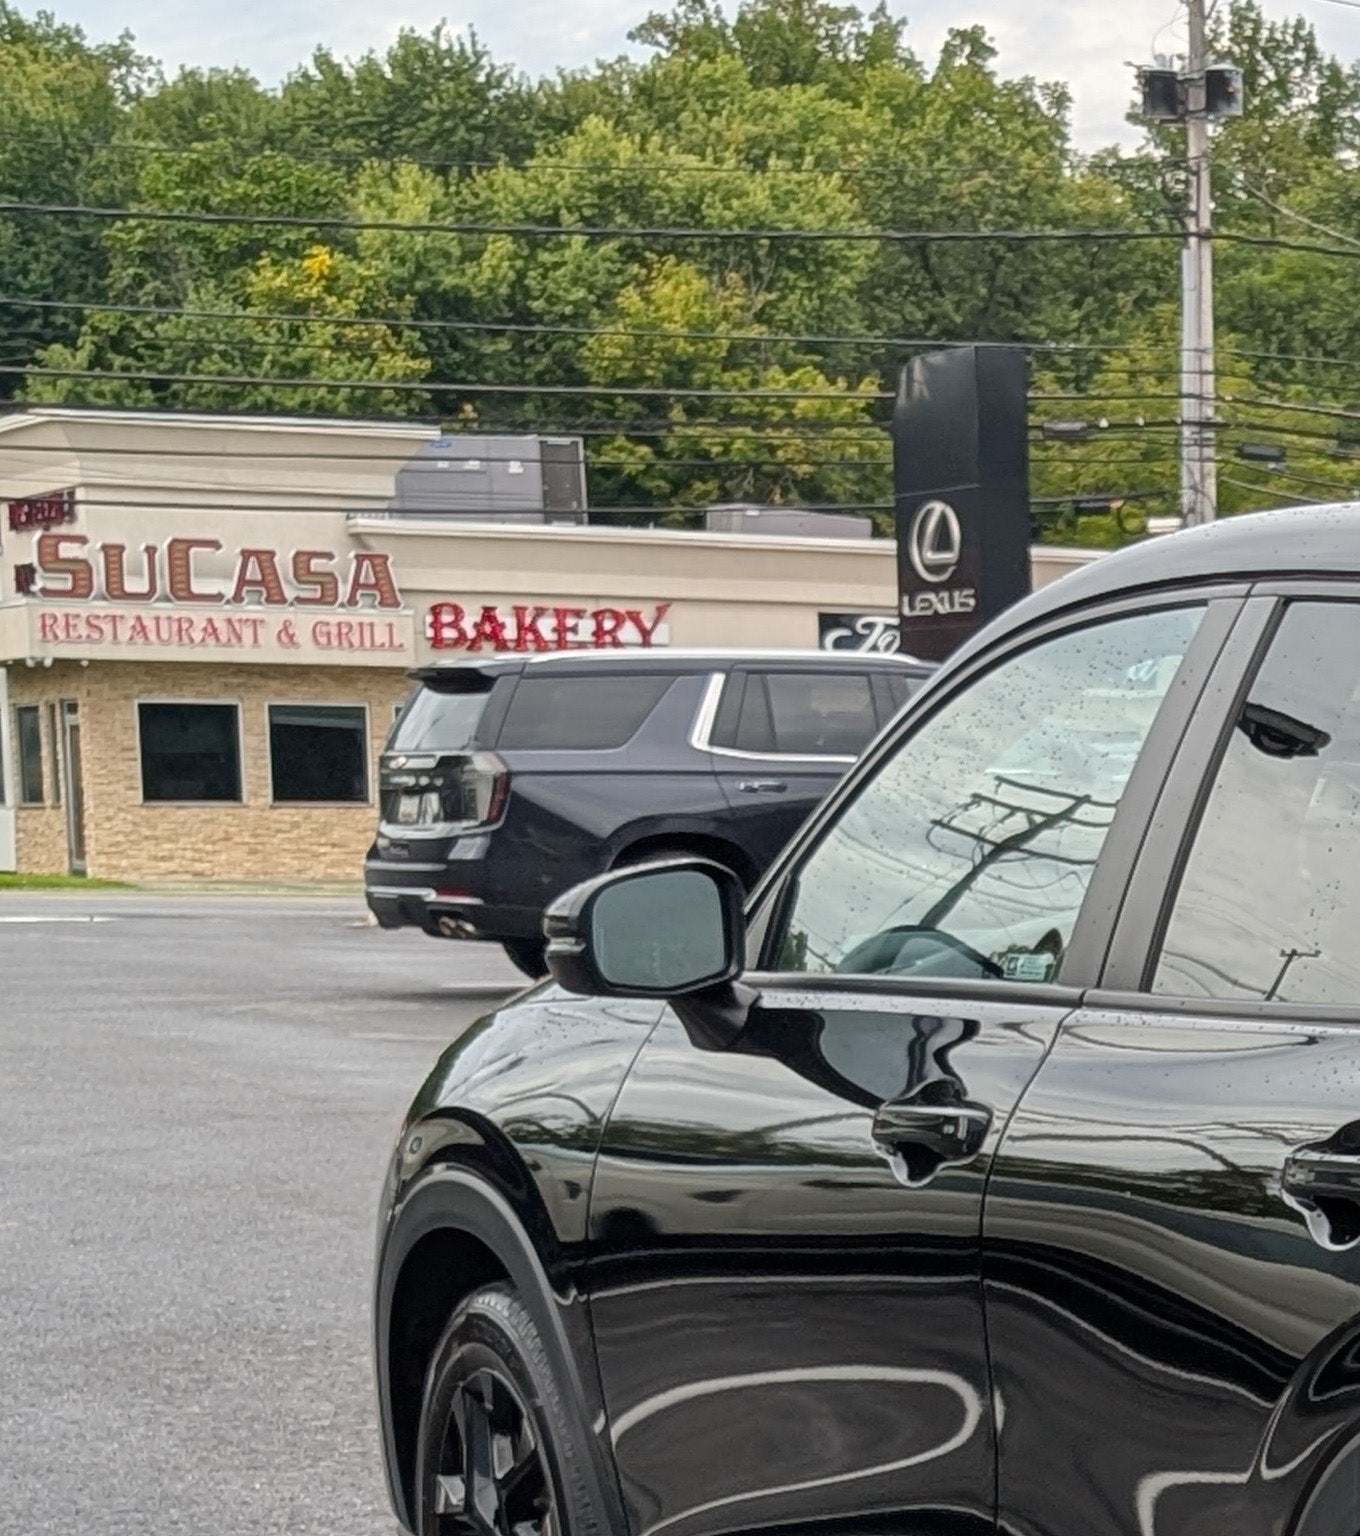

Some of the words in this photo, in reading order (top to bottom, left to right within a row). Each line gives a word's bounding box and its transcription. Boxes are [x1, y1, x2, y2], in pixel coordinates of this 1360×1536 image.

[902, 588, 977, 617] LEXUS
[38, 611, 265, 649] RESTAURANT
[275, 619, 299, 649] &
[311, 620, 405, 651] GRILL
[428, 602, 673, 652] BAKERY
